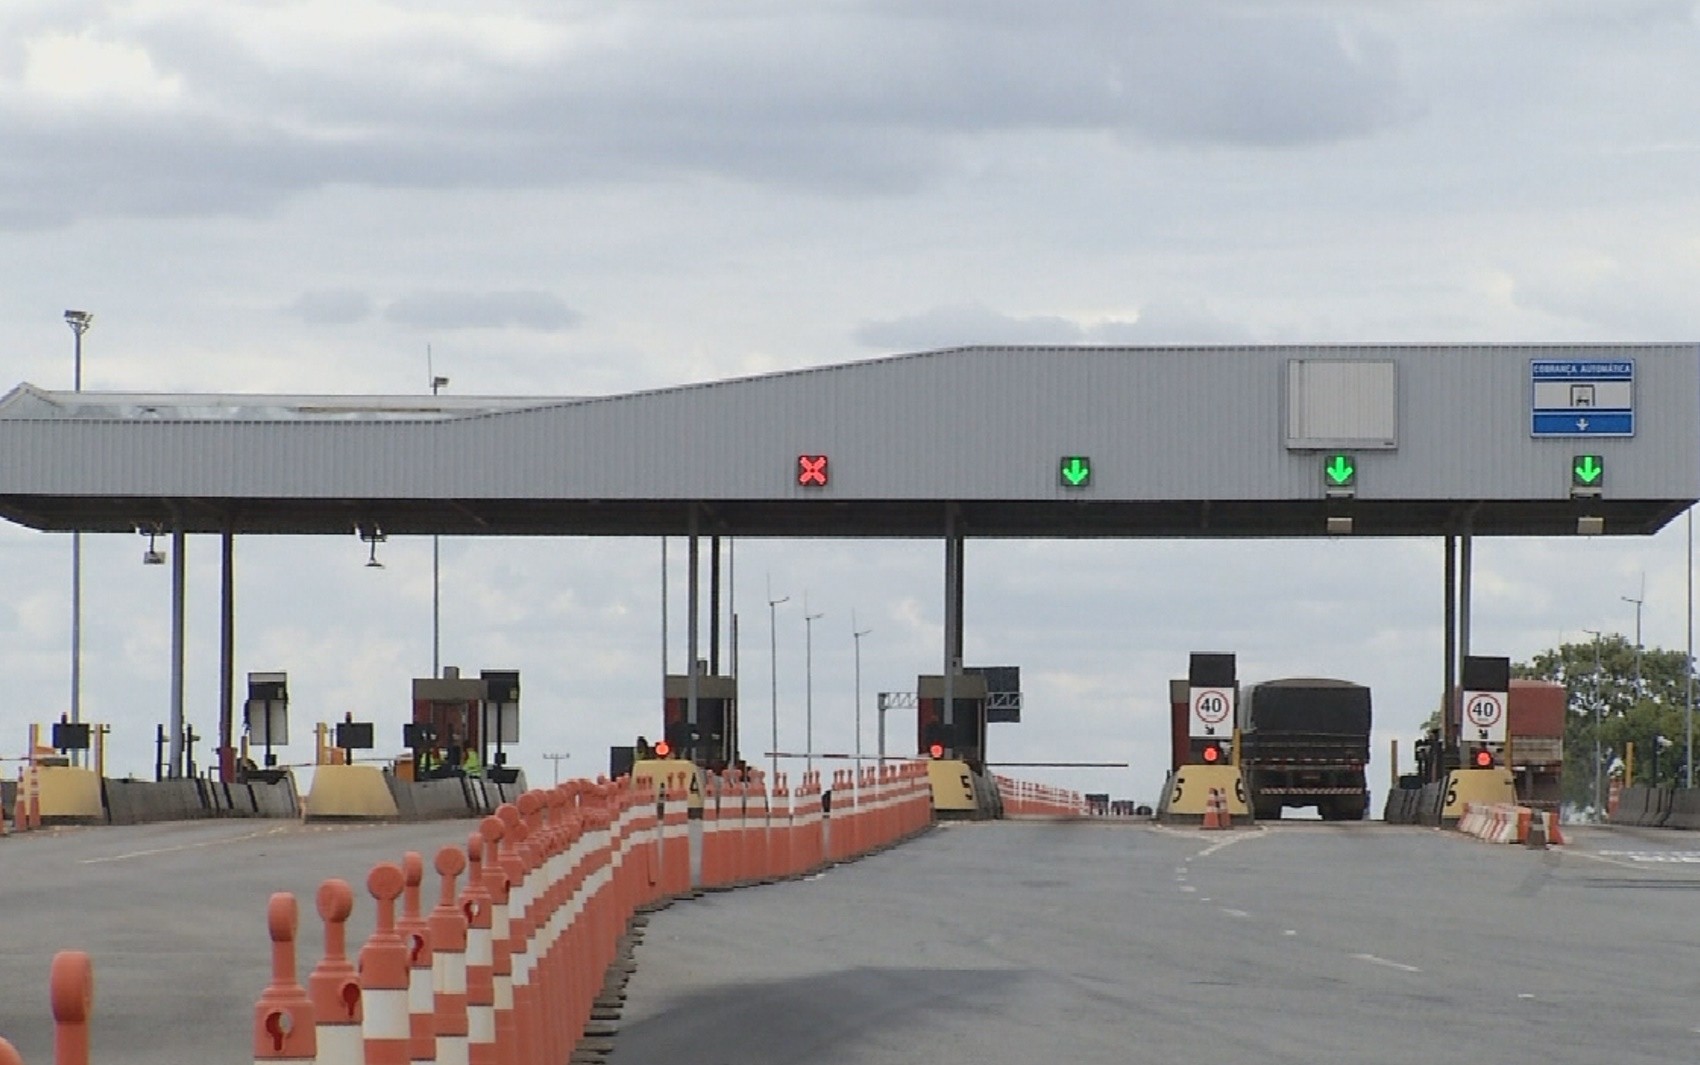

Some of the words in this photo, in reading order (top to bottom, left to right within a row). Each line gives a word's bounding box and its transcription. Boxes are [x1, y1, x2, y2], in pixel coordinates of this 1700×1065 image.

[1533, 364, 1577, 375] COBRANÇA
[1200, 698, 1222, 713] 40
[1472, 702, 1494, 717] 40
[960, 775, 973, 801] 5
[1172, 778, 1186, 804] 5
[1235, 778, 1246, 804] 6
